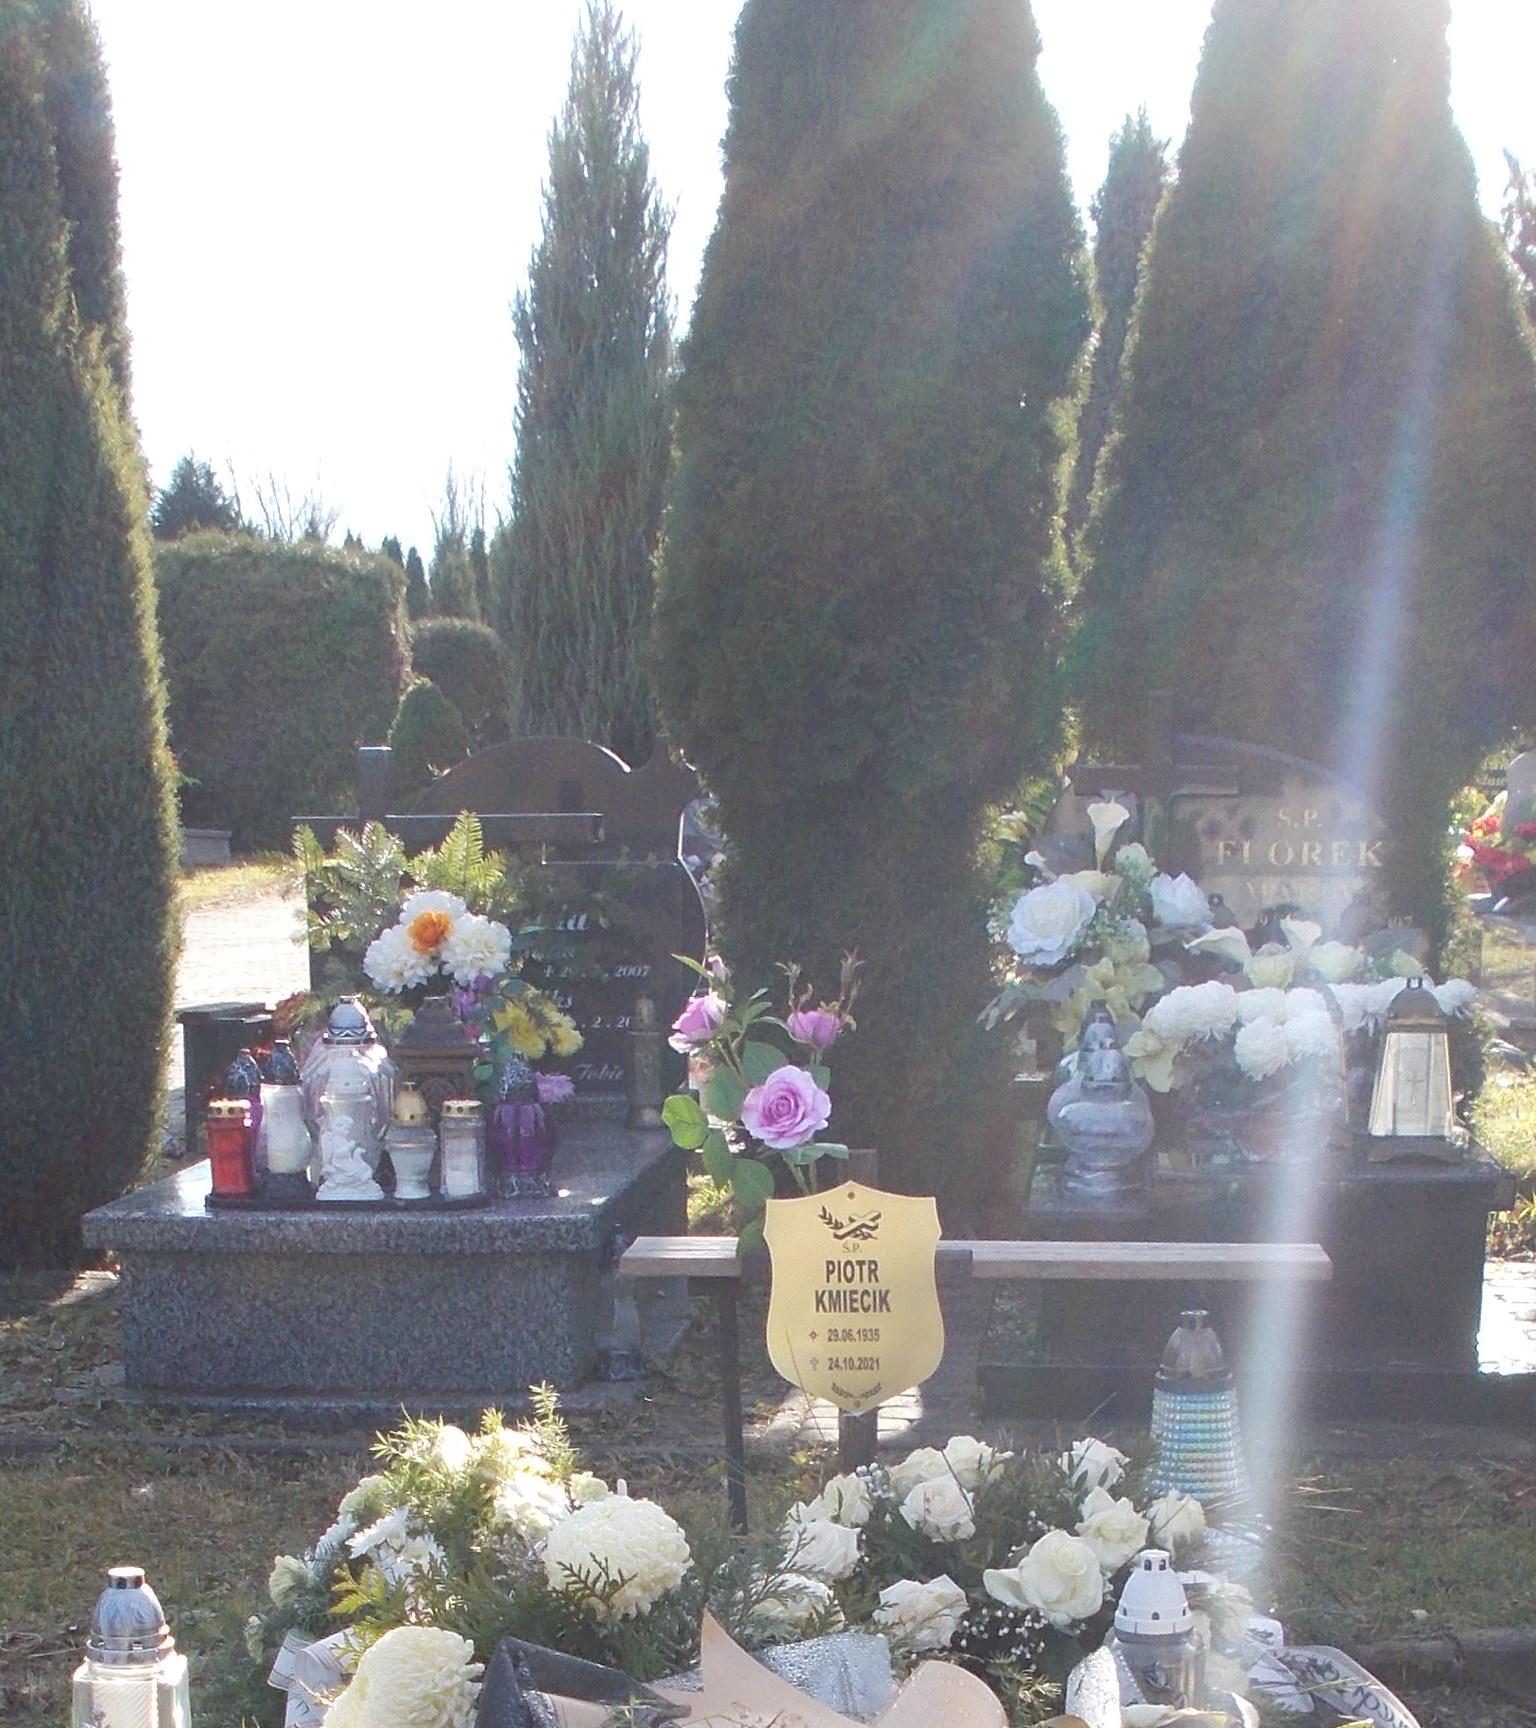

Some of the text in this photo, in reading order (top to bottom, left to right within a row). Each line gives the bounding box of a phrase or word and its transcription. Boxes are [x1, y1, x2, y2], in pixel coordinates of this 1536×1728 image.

[825, 1259, 880, 1284] PIOTR
[814, 1288, 892, 1314] KMIECIK
[827, 1327, 881, 1343] 29.06.1935
[827, 1356, 880, 1371] 24.10.2021
